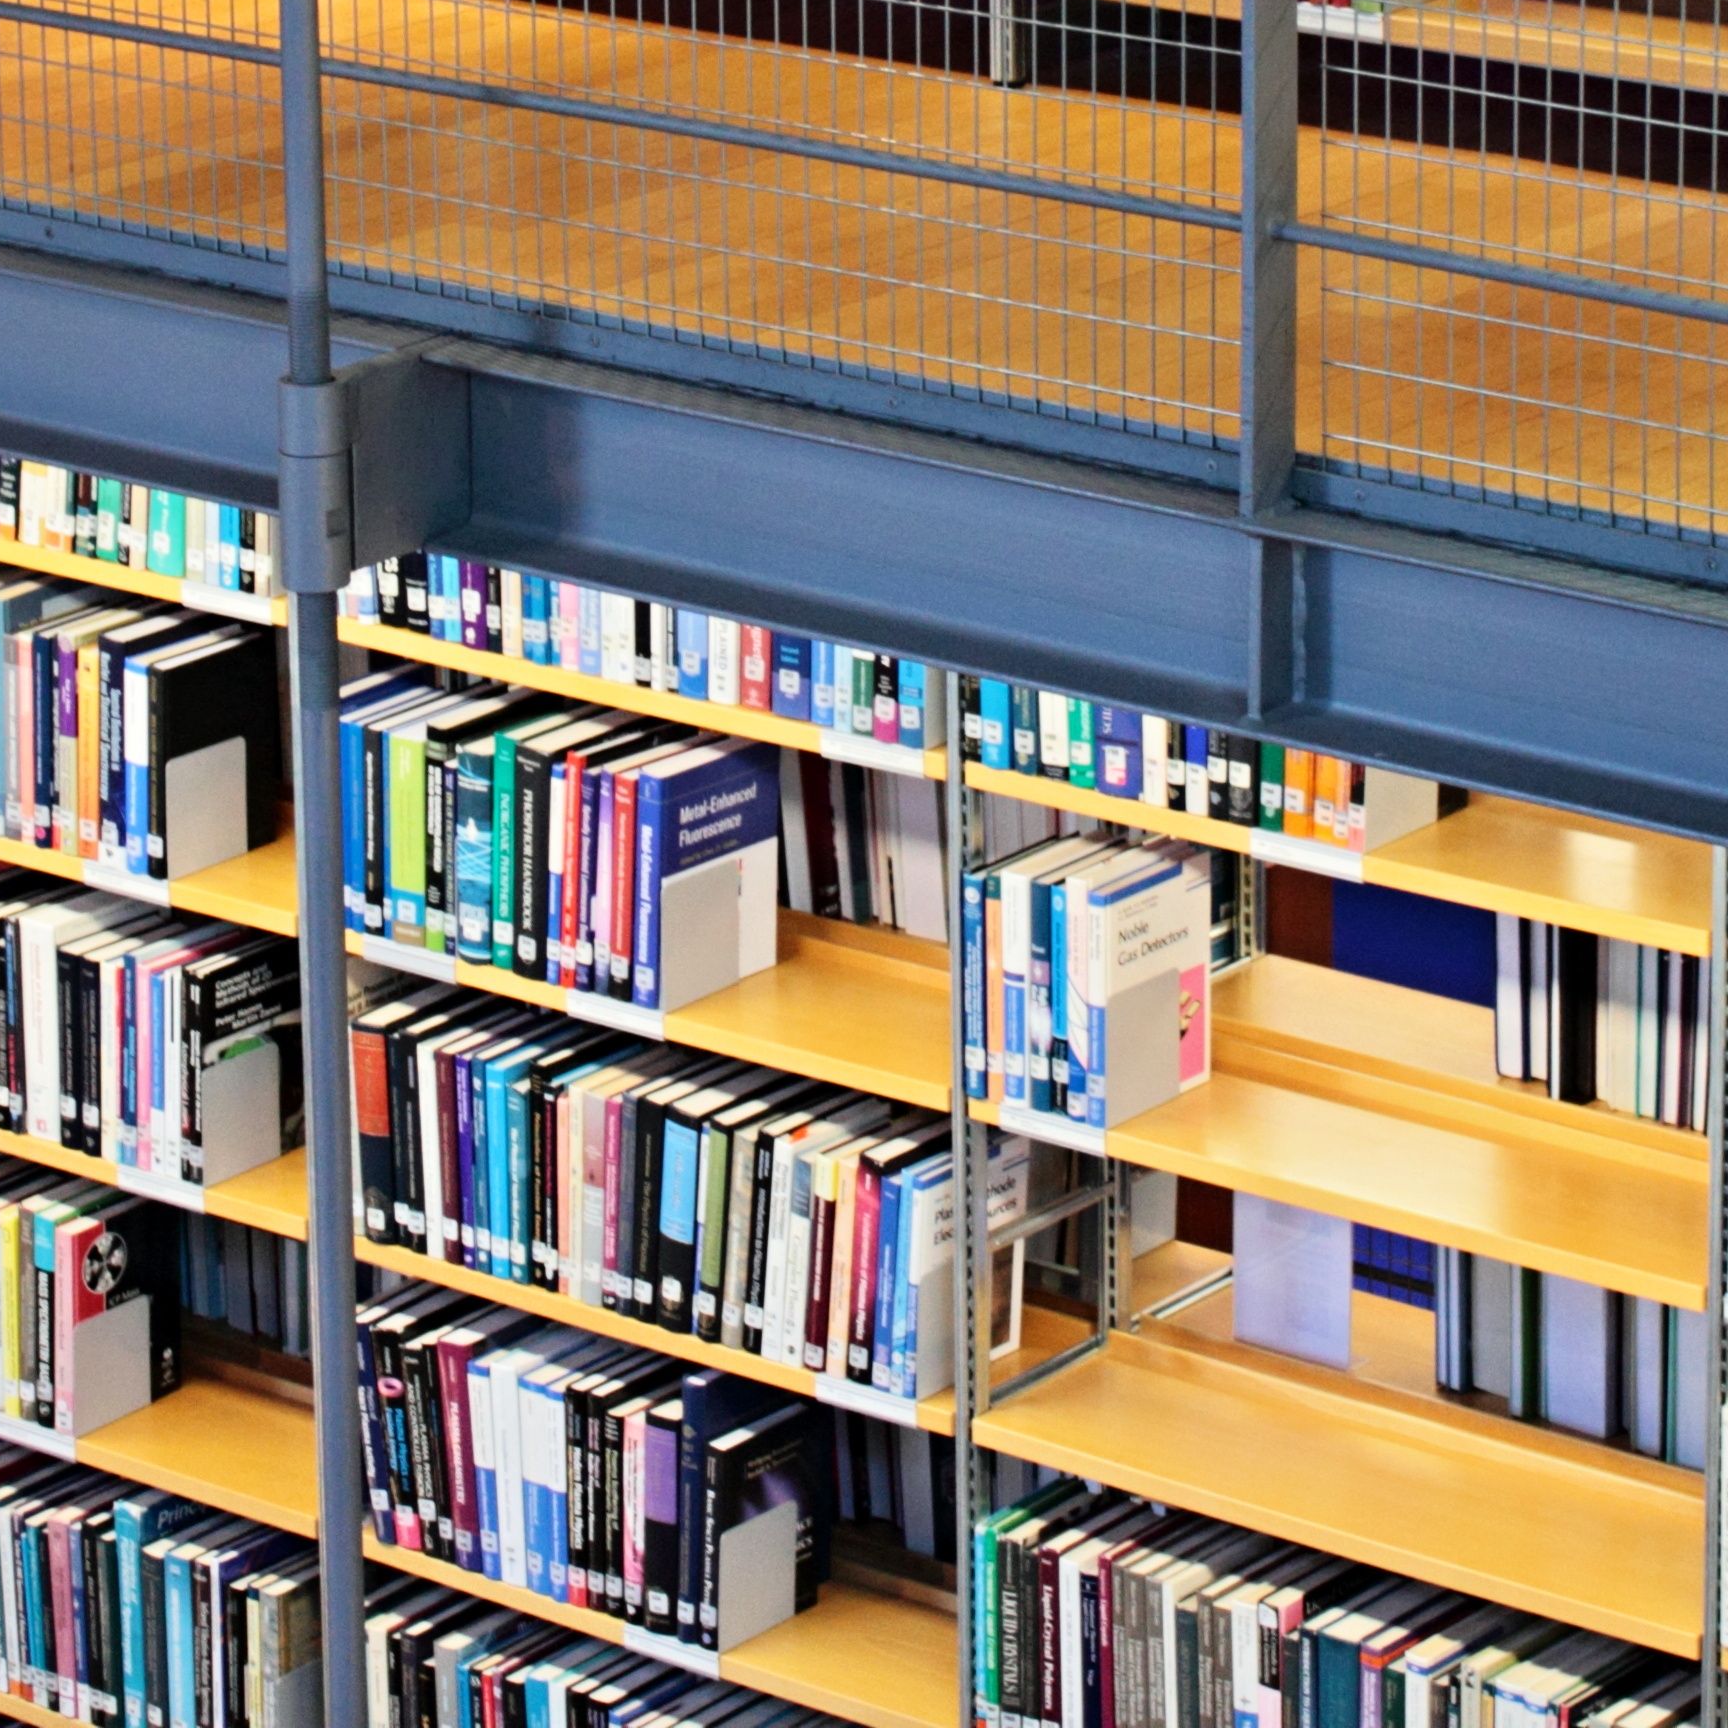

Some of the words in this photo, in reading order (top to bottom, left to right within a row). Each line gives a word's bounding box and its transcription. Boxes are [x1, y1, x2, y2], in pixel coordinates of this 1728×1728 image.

[521, 789, 534, 856] PHOSPHOR
[678, 781, 758, 825] Metal-Enhanced
[678, 813, 743, 848] Fluorescence
[641, 825, 653, 901] Metal-Enhanced
[521, 857, 533, 930] HANDBOOK
[1117, 919, 1151, 944] Noble
[1117, 949, 1140, 967] Gas
[1140, 927, 1190, 958] Detectors
[214, 970, 252, 994] Concepts
[214, 981, 250, 1001] Methods
[214, 992, 249, 1009] Infrared
[753, 1188, 766, 1237] Introduction
[752, 1249, 763, 1279] Plasma
[37, 1272, 49, 1298] MASS
[37, 1300, 49, 1363] SPECTROMETRY
[395, 1408, 406, 1442] Plasma
[451, 1401, 463, 1447] PLASMA
[397, 1443, 408, 1476] Physics
[453, 1448, 467, 1505] CHEMISTRY
[572, 1447, 584, 1482] Modern
[572, 1484, 584, 1515] Plasma
[572, 1516, 584, 1549] Physics
[1002, 1591, 1019, 1632] LIQUID
[1041, 1584, 1054, 1660] Liquid-Crystal
[1002, 1633, 1019, 1694] CRYSTALS
[1041, 1661, 1054, 1710] Polymers
